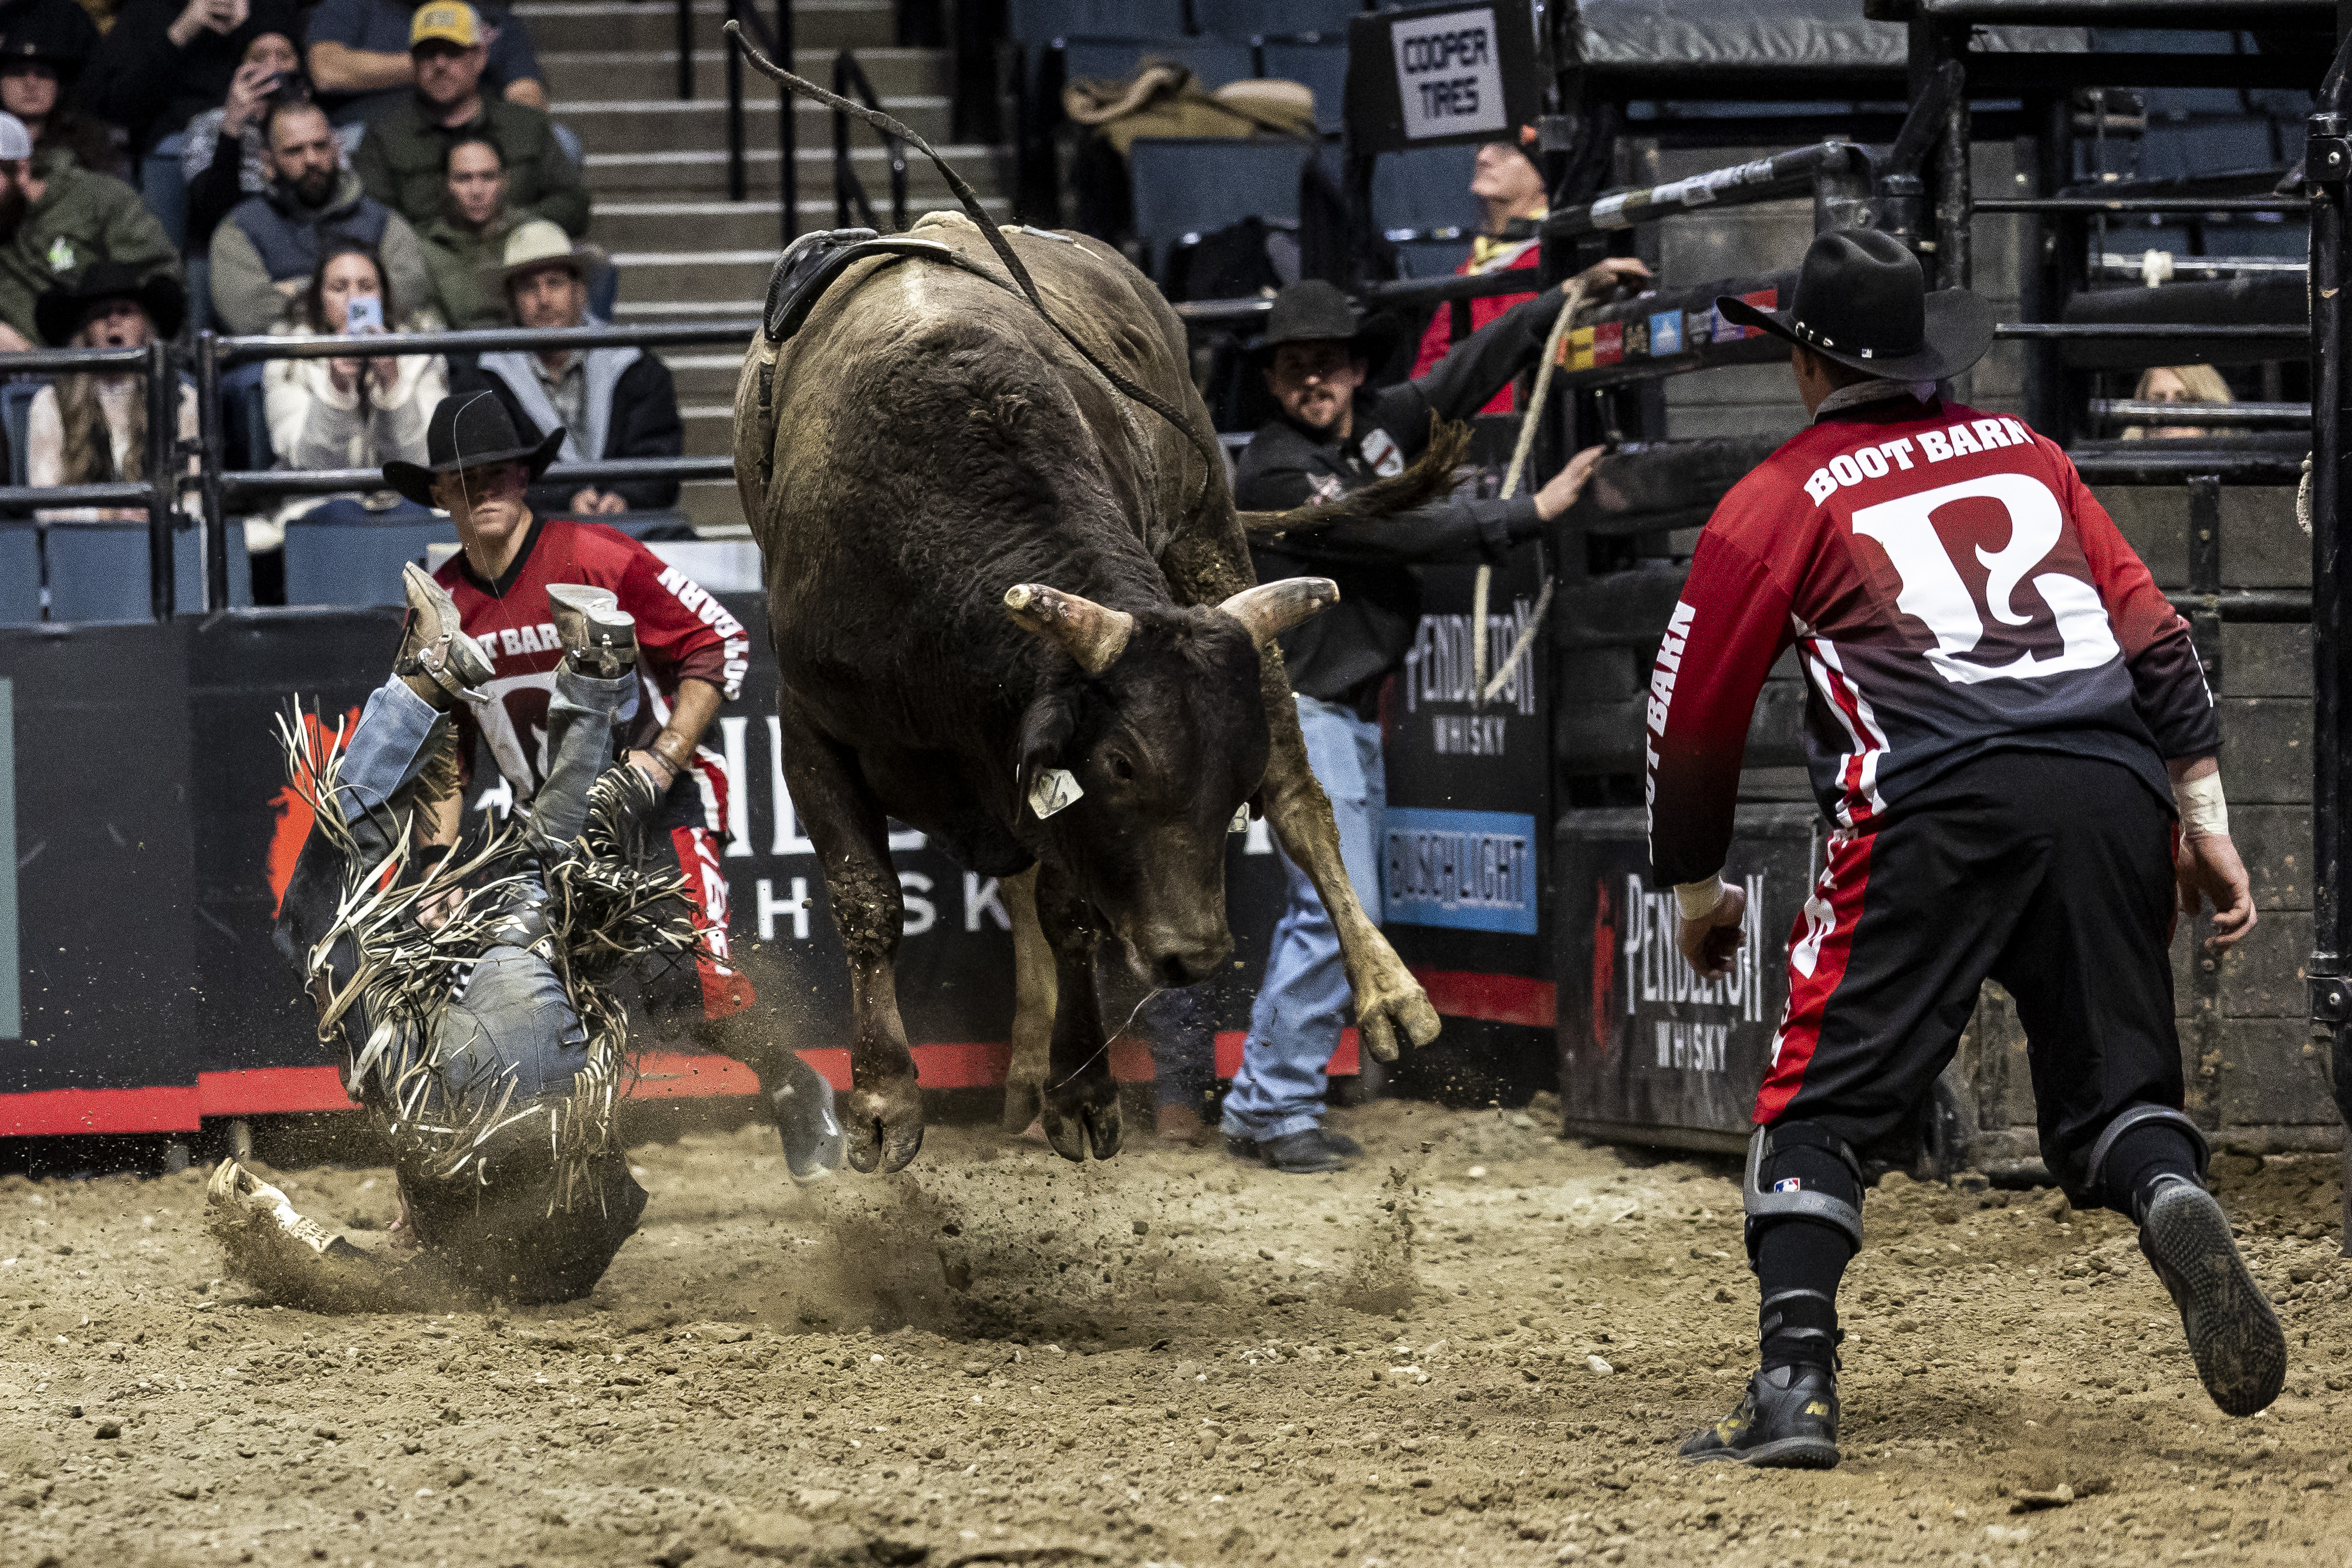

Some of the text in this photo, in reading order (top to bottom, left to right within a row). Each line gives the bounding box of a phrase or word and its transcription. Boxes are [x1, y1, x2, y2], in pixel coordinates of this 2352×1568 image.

[1403, 27, 1489, 74] COOPER
[1803, 417, 2035, 508] BOOT BARN
[499, 623, 563, 657] BAR
[1647, 599, 1697, 738] BARN
[1432, 714, 1507, 756] WHISKY
[1655, 1019, 1729, 1073] WHISKY
